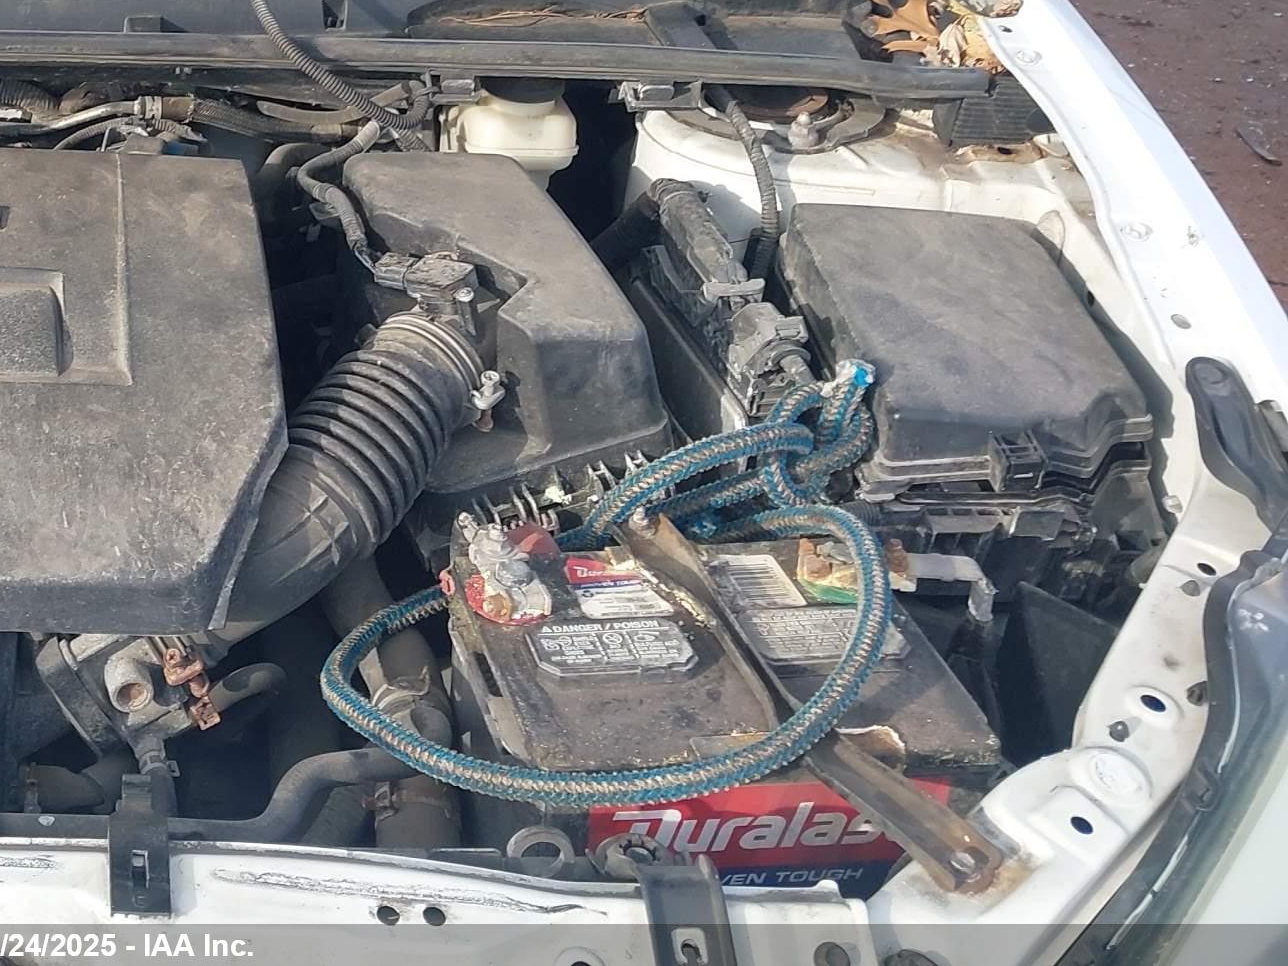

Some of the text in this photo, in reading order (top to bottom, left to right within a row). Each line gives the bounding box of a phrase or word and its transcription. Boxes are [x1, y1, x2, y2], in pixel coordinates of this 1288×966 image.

[552, 623, 603, 633] DANGER
[614, 620, 659, 630] POISON
[613, 801, 884, 853] Duralas
[775, 867, 864, 883] TOUGH
